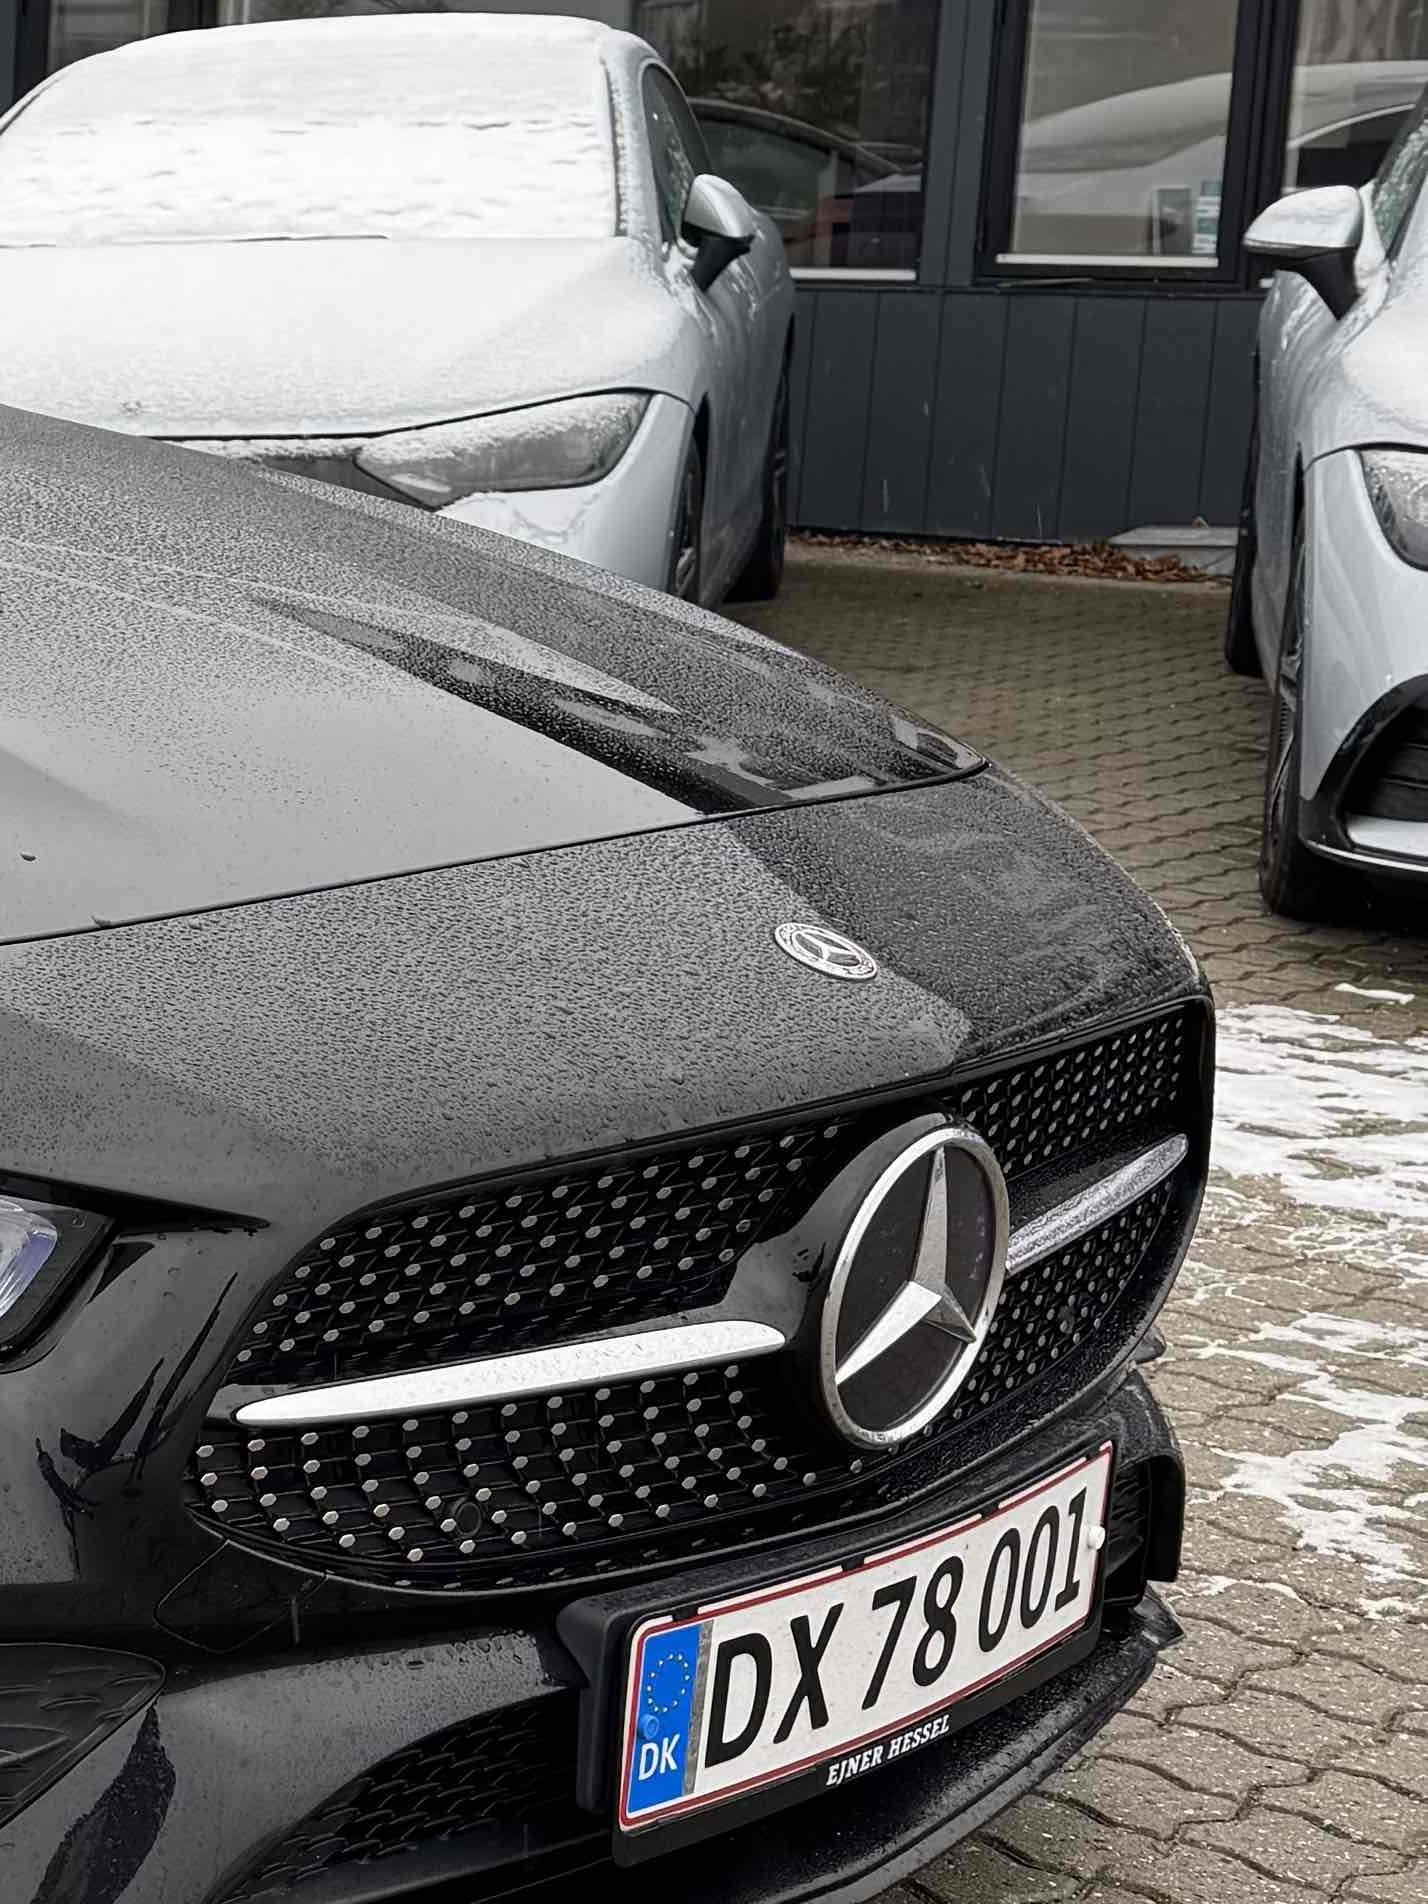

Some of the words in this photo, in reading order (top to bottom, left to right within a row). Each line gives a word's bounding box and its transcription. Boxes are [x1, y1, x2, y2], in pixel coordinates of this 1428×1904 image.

[704, 1602, 843, 1768] DX
[861, 1556, 964, 1710] 78
[977, 1487, 1087, 1652] 001
[637, 1733, 679, 1781] DK
[826, 1745, 884, 1786] EJNER
[887, 1714, 950, 1759] HESSEL
